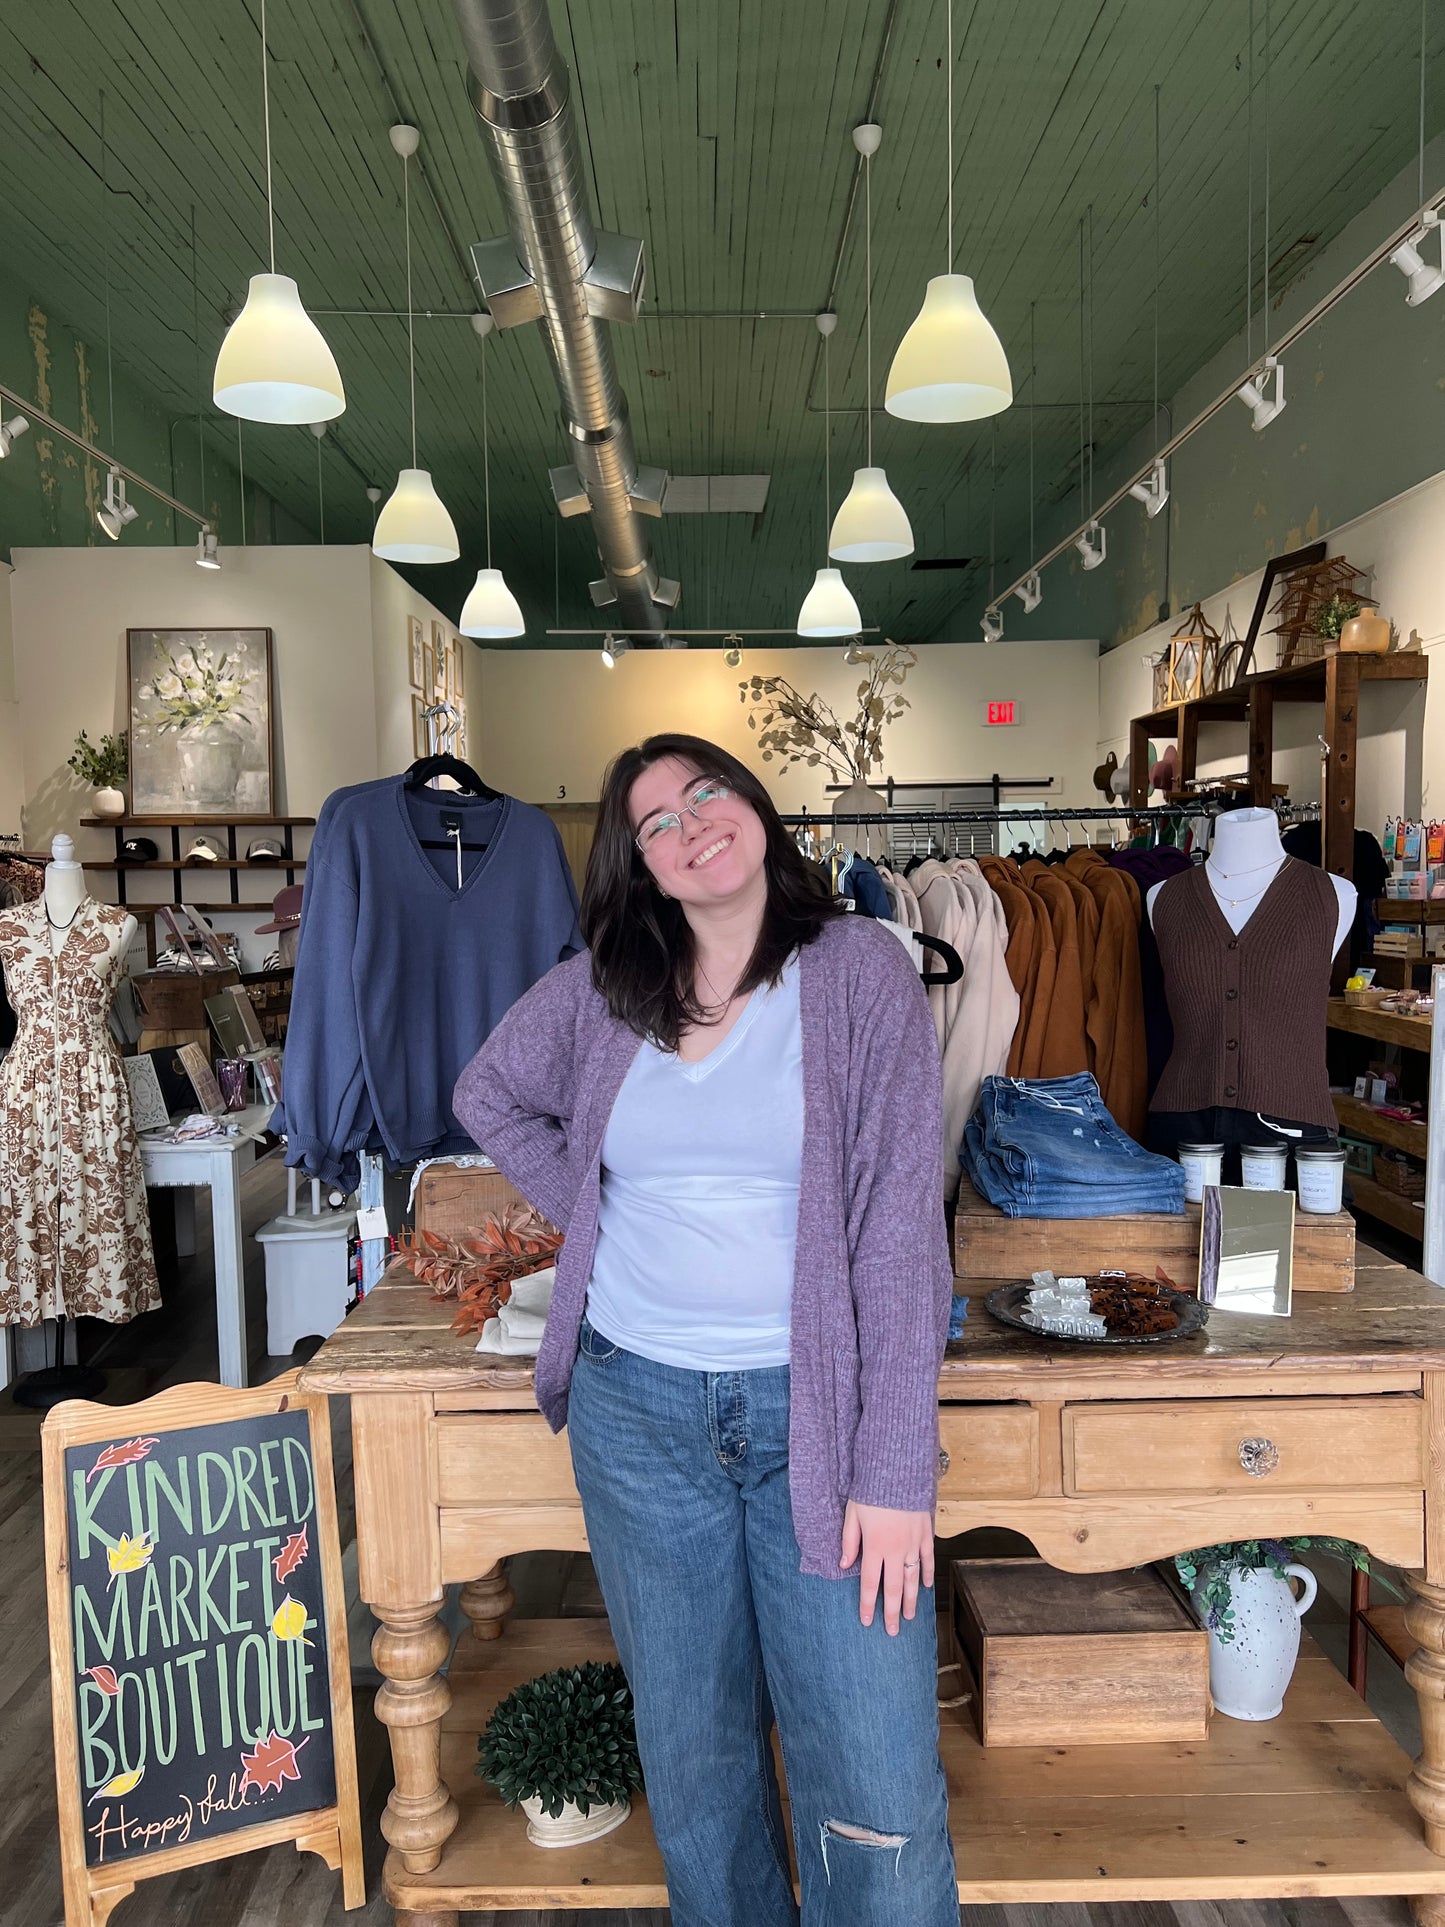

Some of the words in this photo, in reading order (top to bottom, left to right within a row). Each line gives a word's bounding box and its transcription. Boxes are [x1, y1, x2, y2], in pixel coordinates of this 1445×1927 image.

[988, 701, 1015, 724] EXIT
[556, 785, 566, 799] 3
[72, 1437, 314, 1560] KINDRED
[75, 1536, 281, 1671] MARKET
[81, 1618, 324, 1789] BOUTIQUE
[88, 1794, 193, 1861] Happy
